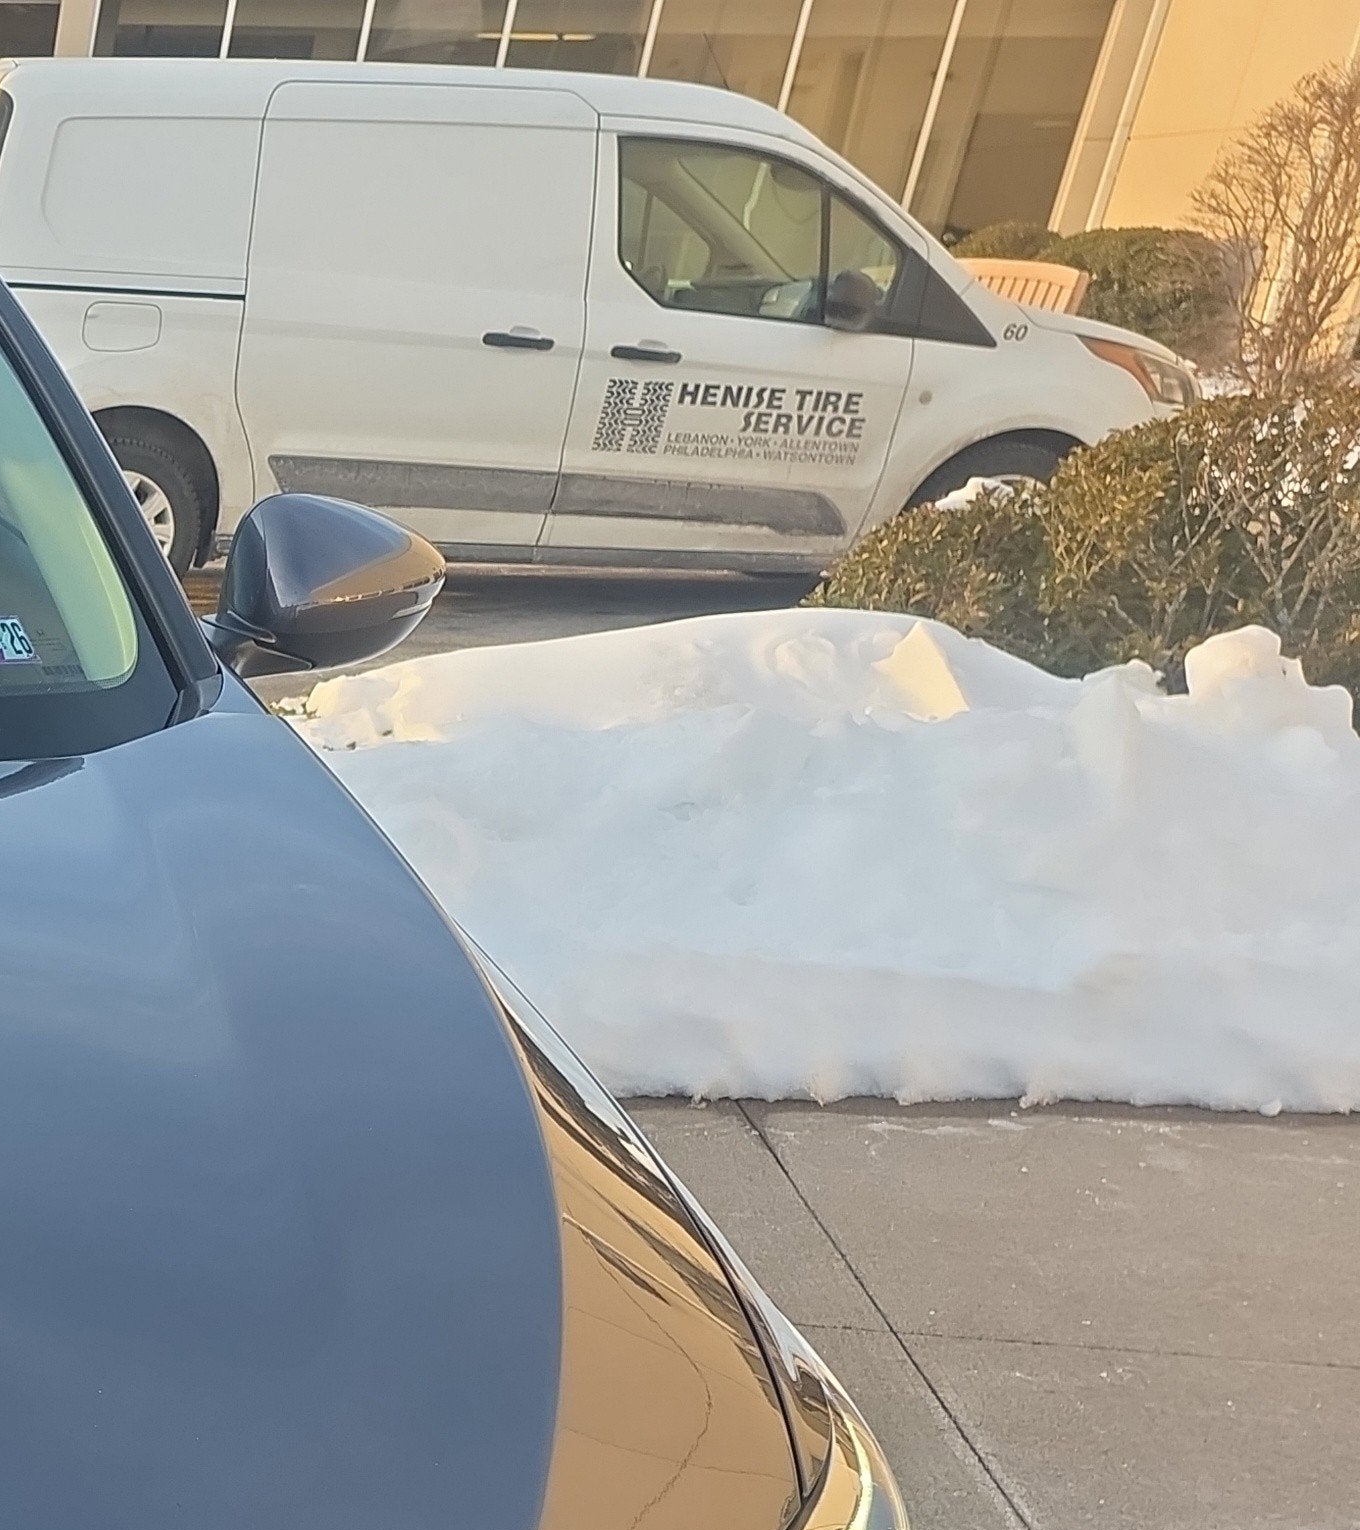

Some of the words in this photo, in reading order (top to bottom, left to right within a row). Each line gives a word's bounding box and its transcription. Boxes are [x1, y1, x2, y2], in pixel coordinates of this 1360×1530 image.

[1003, 323, 1029, 341] 60
[678, 382, 786, 410] HENISE
[795, 388, 863, 414] TIRE
[740, 411, 866, 438] SERVICE
[666, 431, 729, 446] LEBANON
[738, 435, 772, 448] YORK
[780, 438, 860, 453] ALLENTOWN
[663, 444, 753, 460] PHILADELPHIA
[763, 450, 857, 466] WATSONTOWN
[0, 622, 33, 655] 26
